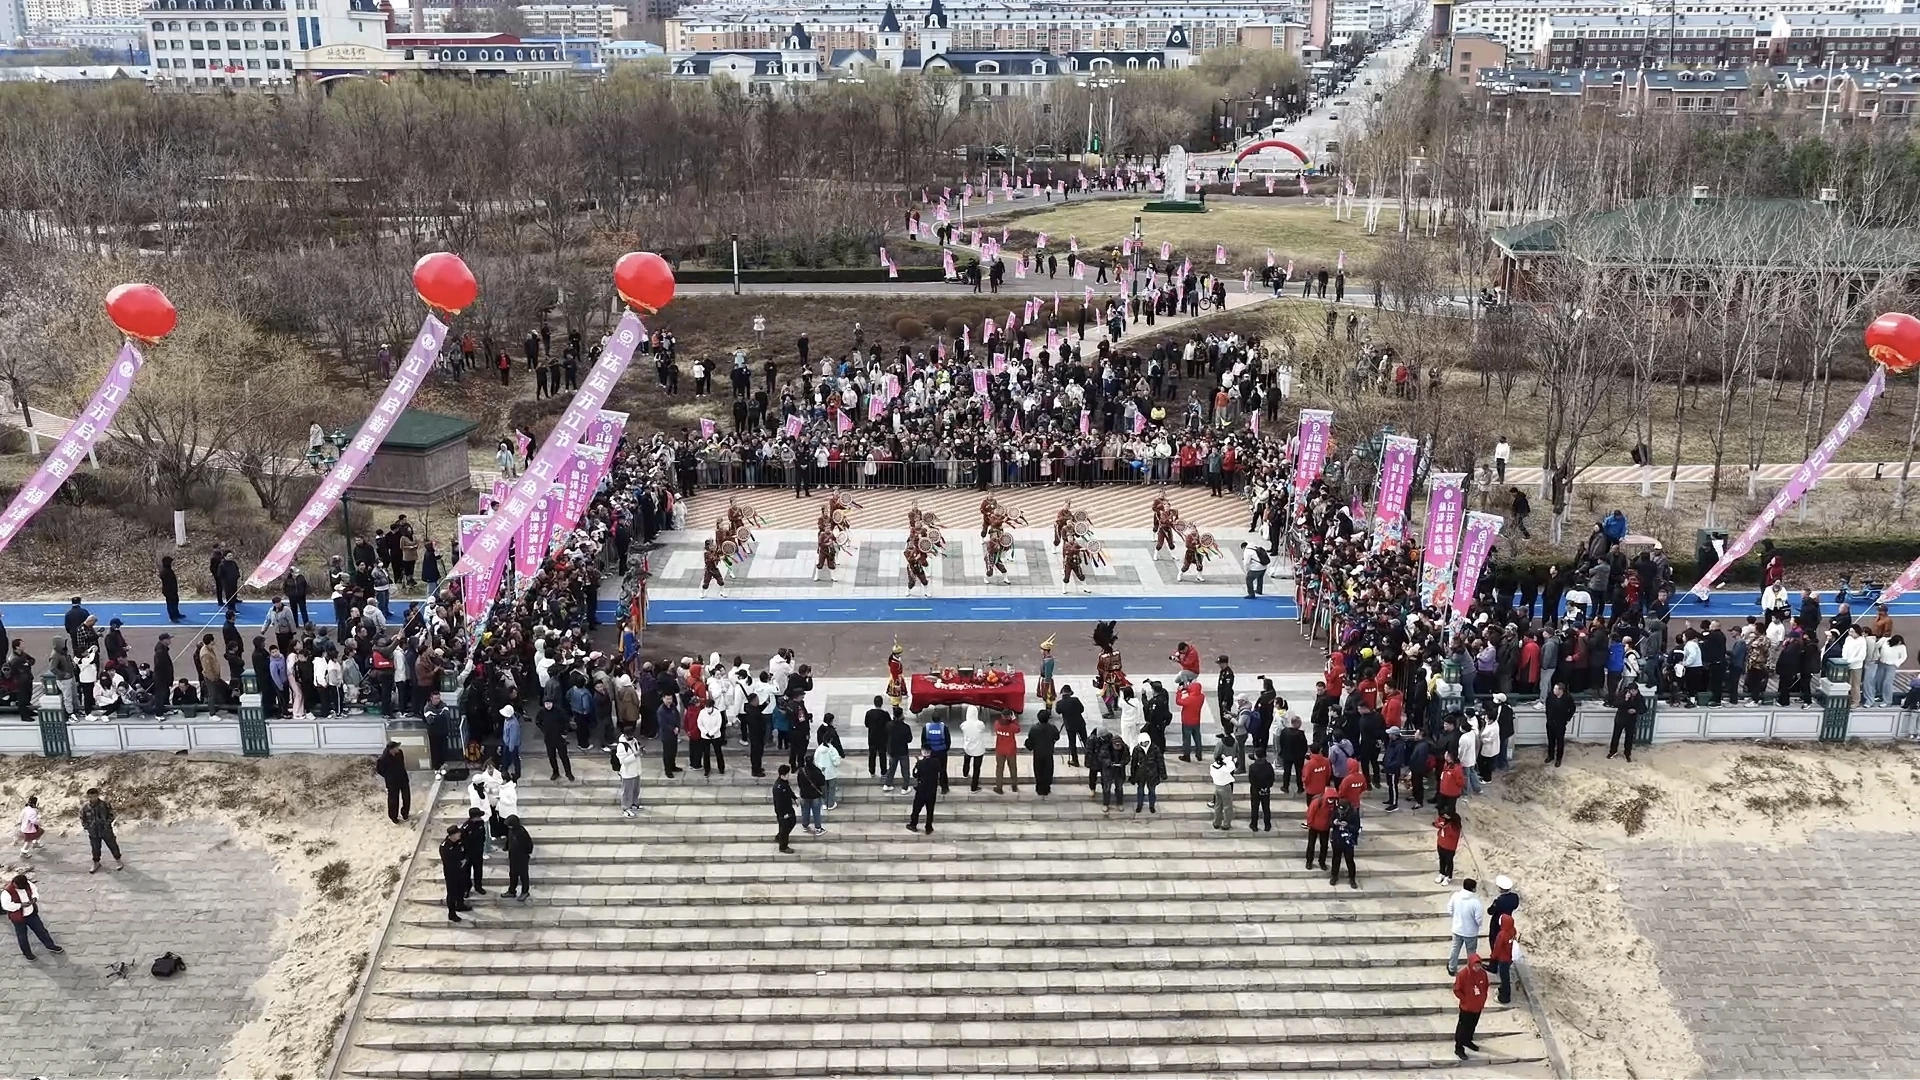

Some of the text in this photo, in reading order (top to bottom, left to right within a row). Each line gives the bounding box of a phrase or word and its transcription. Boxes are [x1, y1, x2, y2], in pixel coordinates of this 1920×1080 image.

[46, 382, 123, 479] 江开启新程
[278, 355, 425, 553] 江开启新程 福泽满东极
[480, 352, 622, 553] 抚远开江节 江鱼顺丰奇
